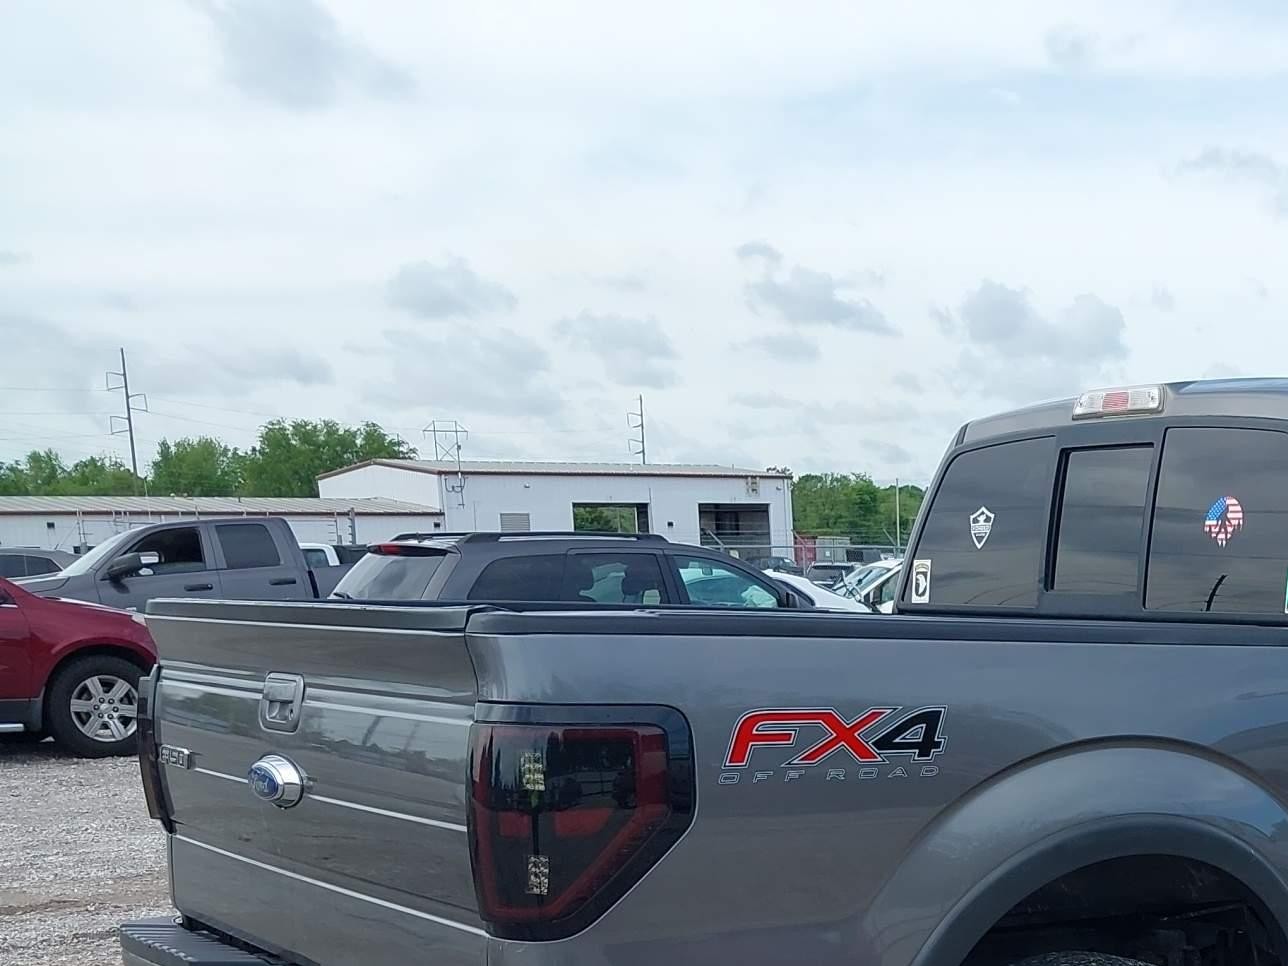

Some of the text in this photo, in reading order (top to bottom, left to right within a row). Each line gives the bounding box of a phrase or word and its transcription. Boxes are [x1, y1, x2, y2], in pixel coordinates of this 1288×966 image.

[721, 705, 949, 769] FX4
[718, 766, 941, 785] OFF ROAD
